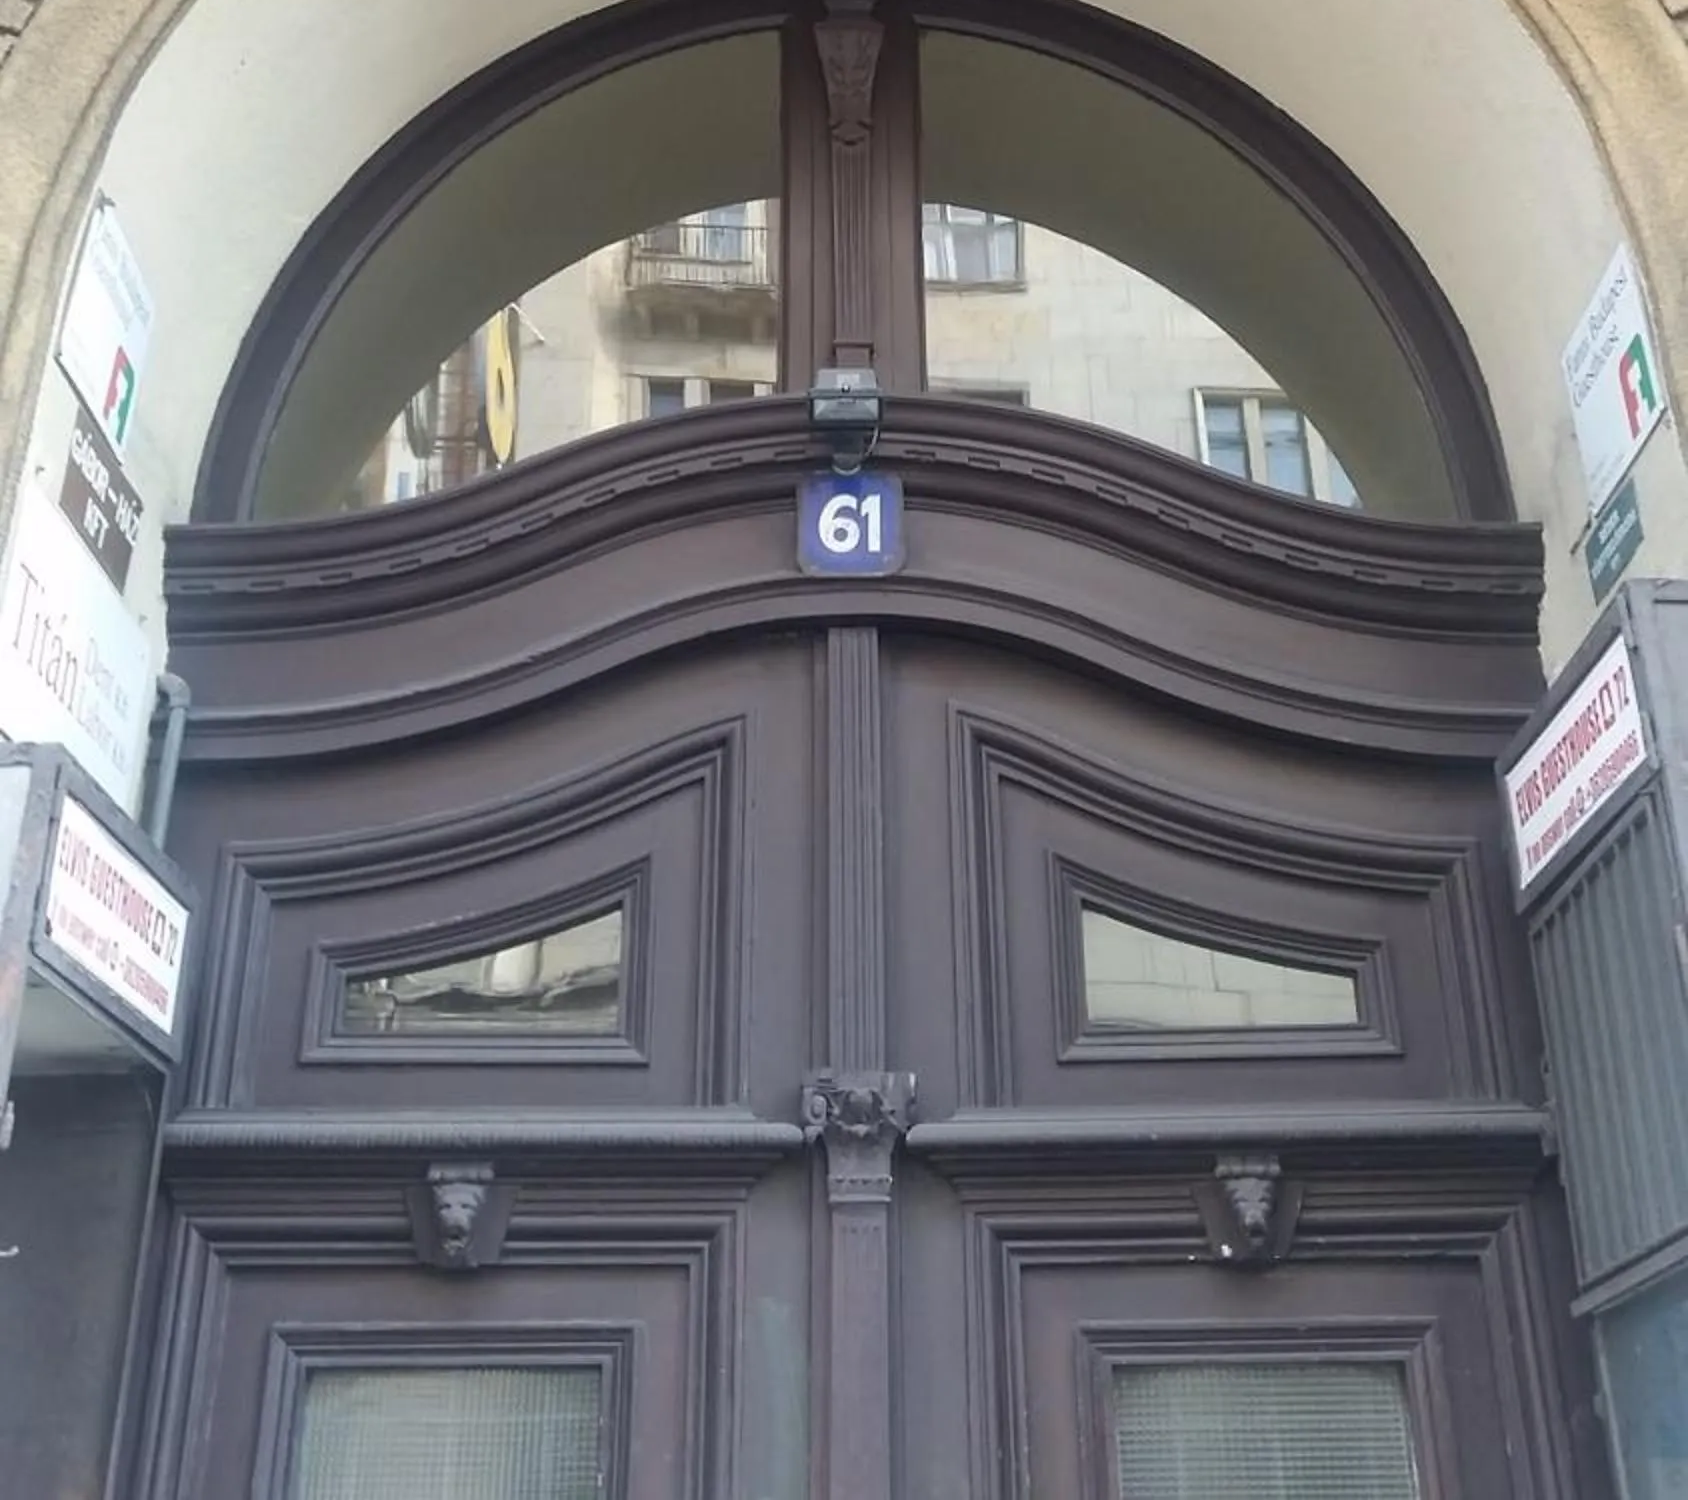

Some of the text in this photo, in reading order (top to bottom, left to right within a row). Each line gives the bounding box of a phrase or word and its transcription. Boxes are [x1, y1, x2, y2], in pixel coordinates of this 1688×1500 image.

[84, 497, 109, 549] KFT
[818, 493, 881, 553] 61
[1515, 768, 1543, 827] ELVIS
[1540, 697, 1603, 799] GUESTHOUSE
[59, 824, 91, 887] ELVIS
[90, 853, 154, 945] GUESTHOUSE
